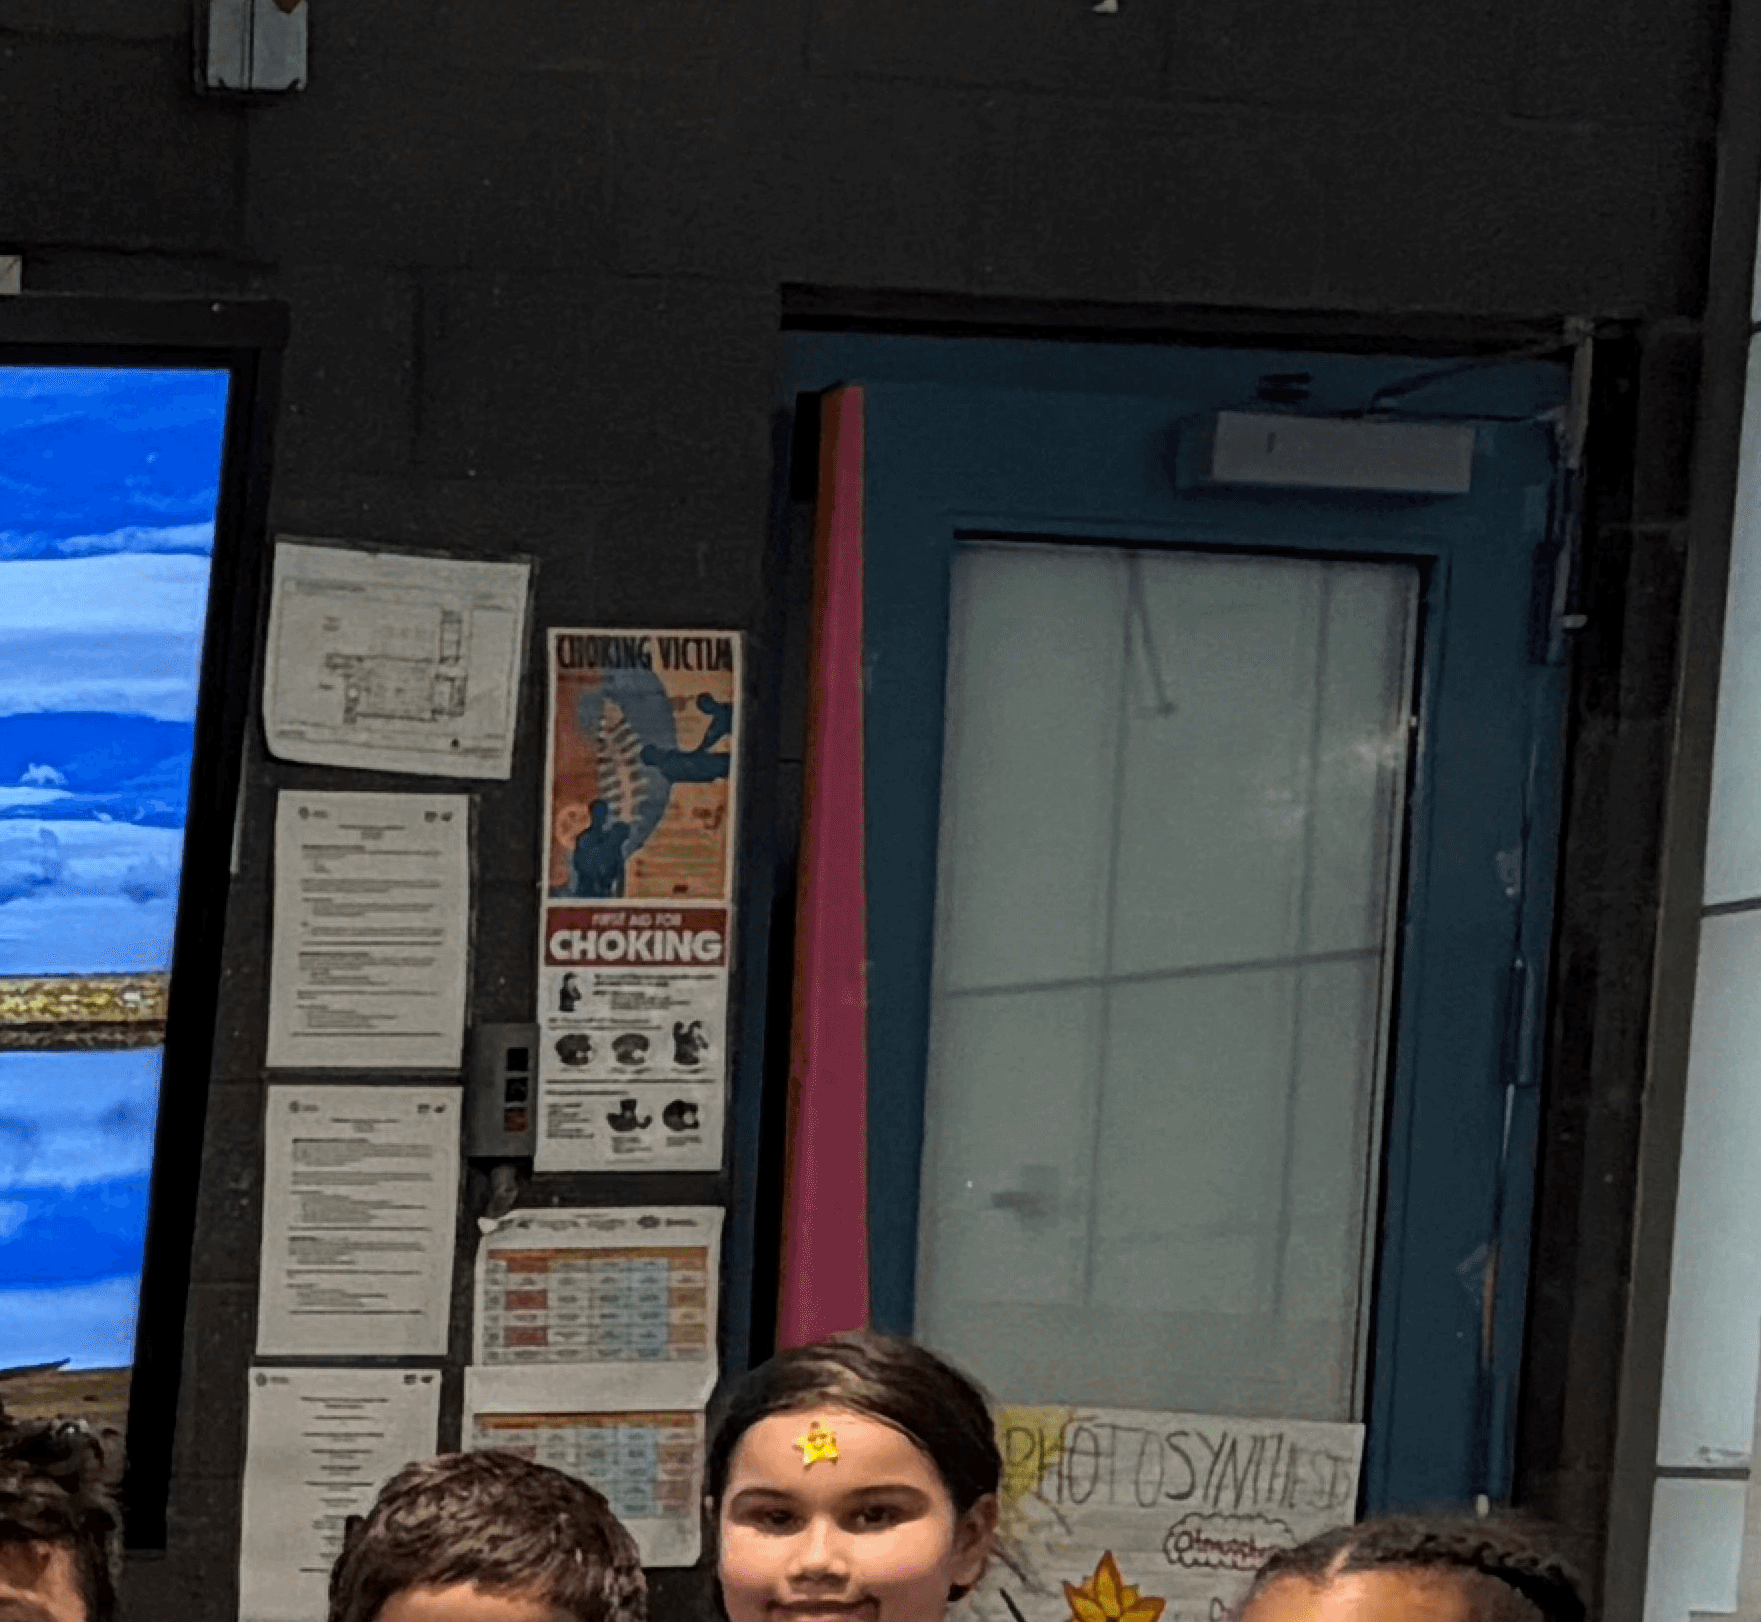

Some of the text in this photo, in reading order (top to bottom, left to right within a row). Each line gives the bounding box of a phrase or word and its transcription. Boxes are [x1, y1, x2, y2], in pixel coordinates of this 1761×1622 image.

[591, 911, 683, 927] FIRST AID FOR
[550, 928, 722, 963] CHOKING
